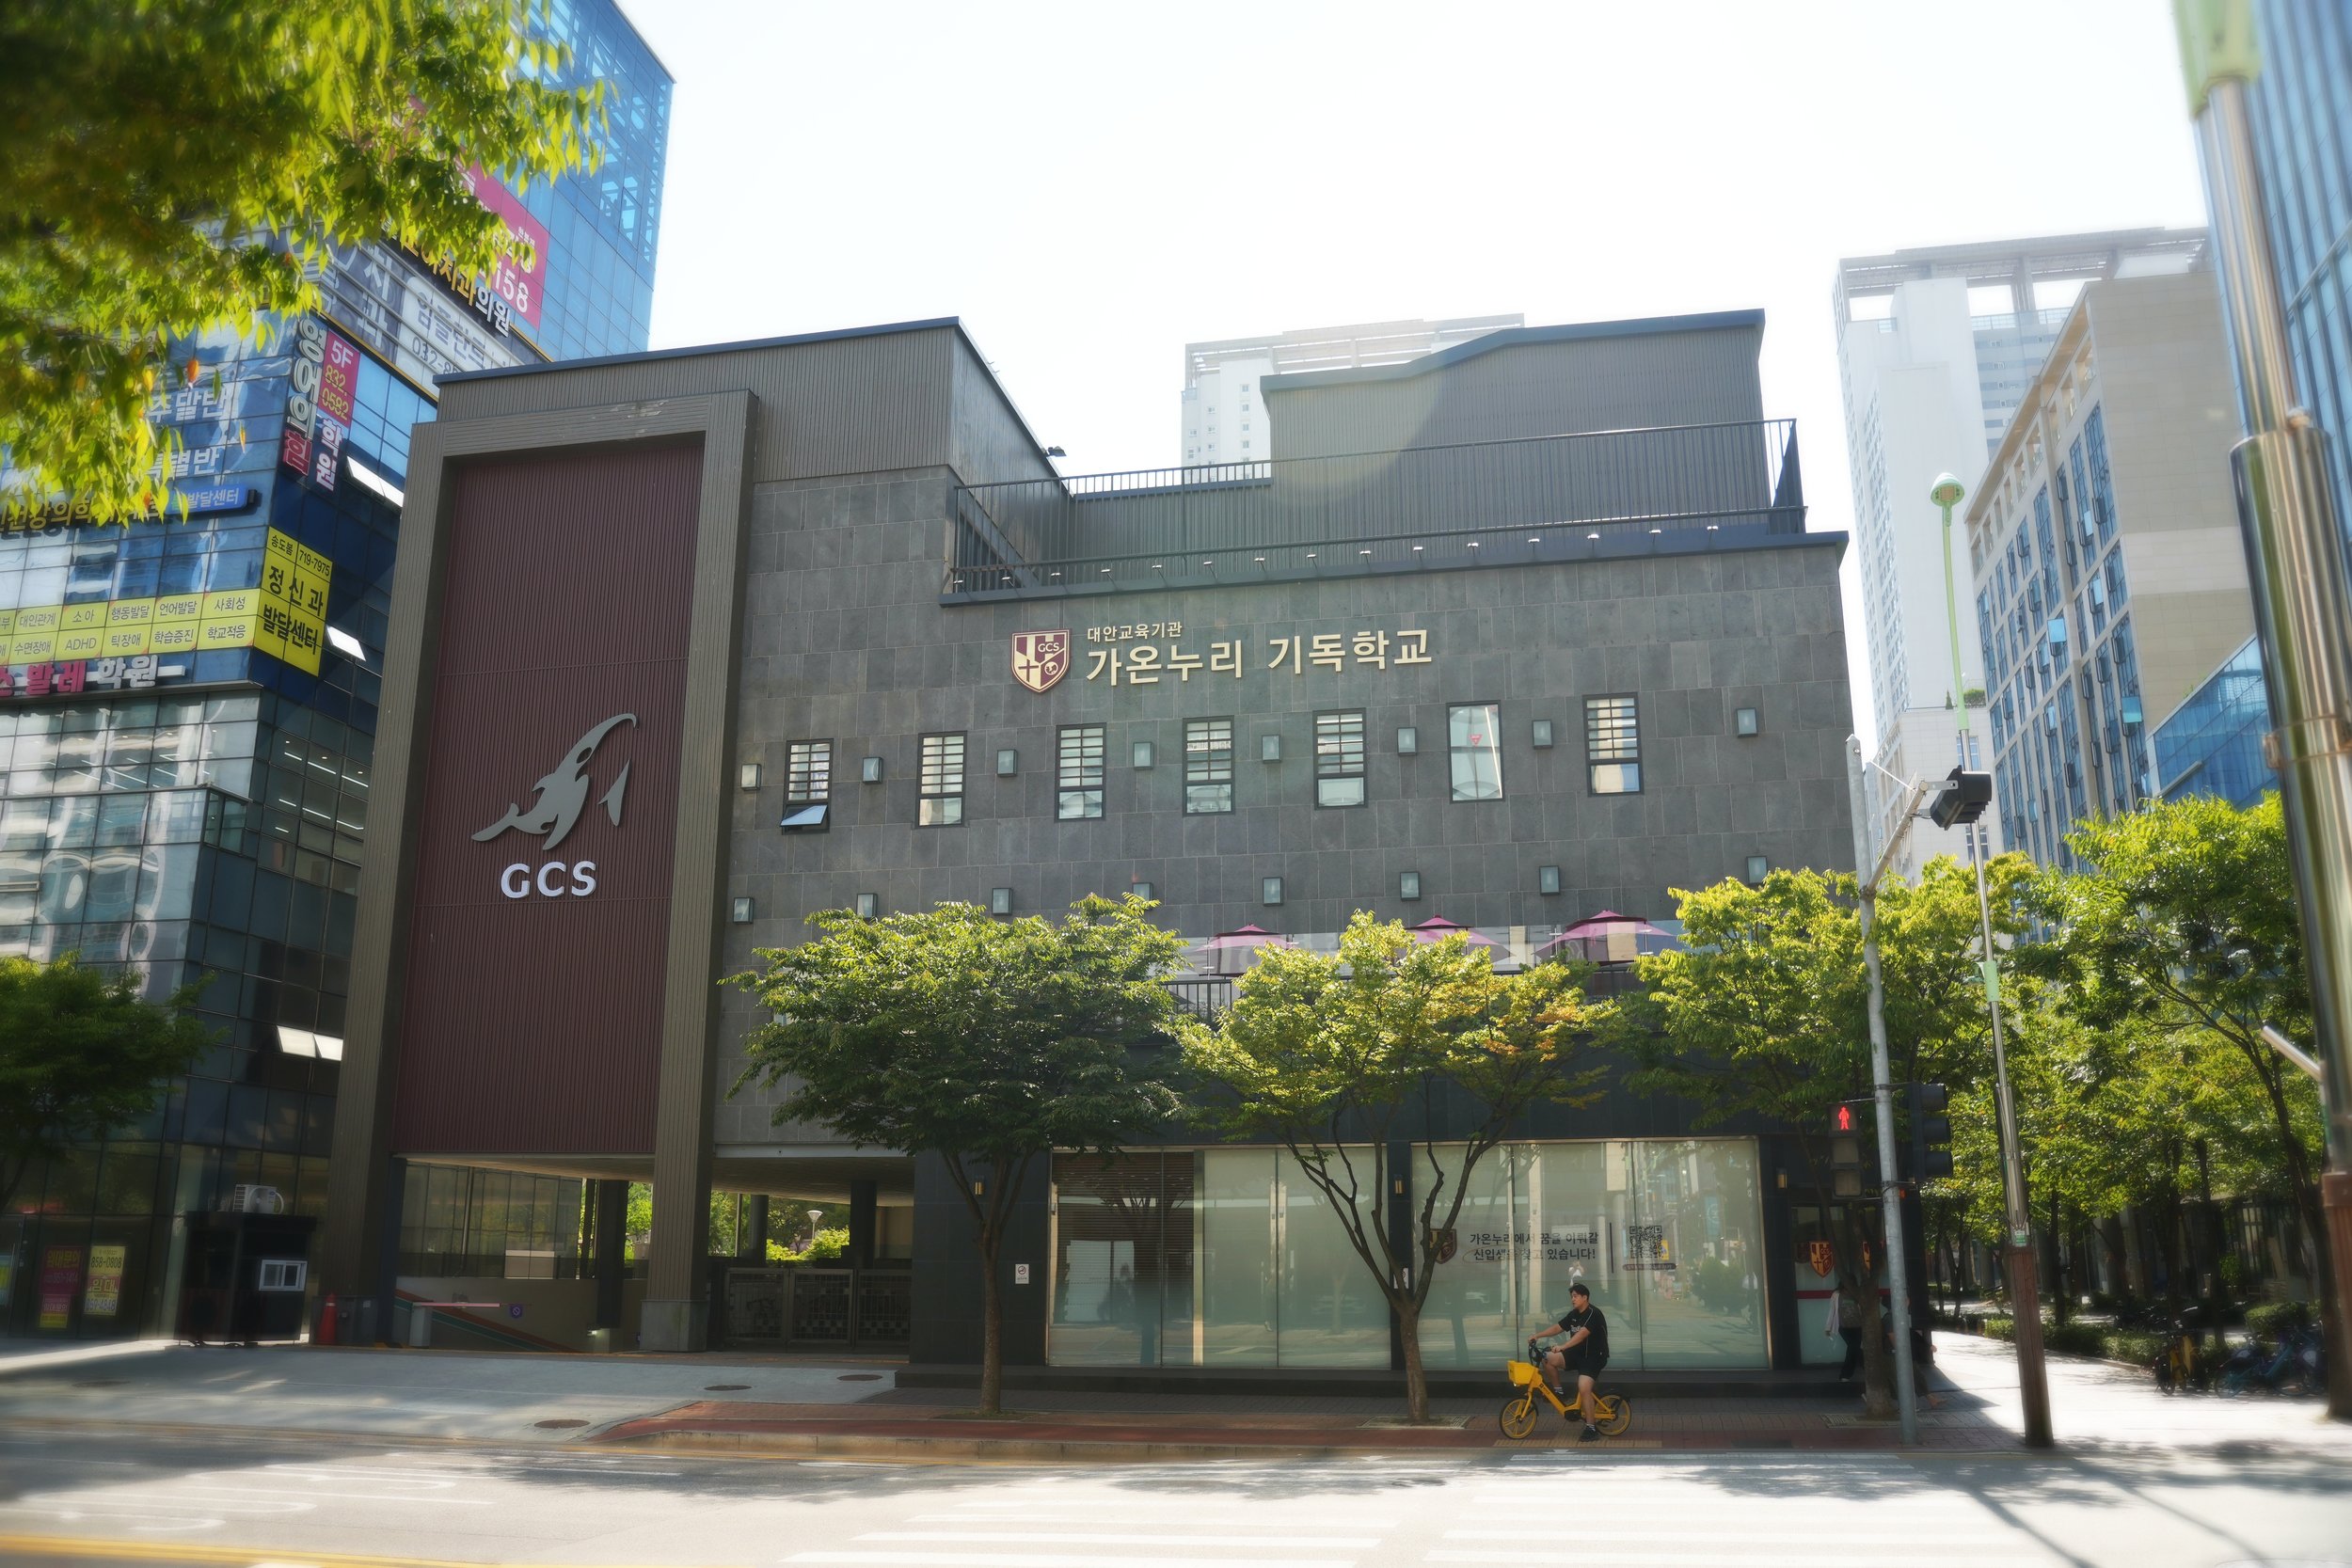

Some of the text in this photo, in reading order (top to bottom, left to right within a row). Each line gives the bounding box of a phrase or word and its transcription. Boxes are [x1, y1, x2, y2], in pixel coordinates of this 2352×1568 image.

[417, 291, 485, 371] 임플란트
[330, 340, 354, 369] 5F
[321, 388, 349, 420] 0582
[316, 418, 343, 492] 학원
[299, 549, 330, 578] 719-7975
[159, 600, 198, 616] 언어발달
[215, 596, 246, 611] 사회성
[19, 612, 56, 627] 대인관계
[111, 605, 151, 621] 행동발달
[154, 628, 195, 645] 학습증진
[207, 625, 246, 640] 학교적응
[262, 604, 319, 656] 발달센터
[1088, 621, 1183, 642] 대안교육기관
[65, 638, 97, 651] ADHD
[111, 633, 142, 647] 틱장애
[1038, 641, 1060, 653] GCS
[14, 641, 52, 656] 수면장애
[1086, 627, 1433, 687] 가온누리 기독학교
[25, 659, 87, 696] 발레
[97, 654, 159, 689] 학원
[501, 860, 597, 899] GCS
[1470, 1231, 1598, 1245] 가온누리에서 꿈을 이뤄갈
[1547, 1247, 1596, 1260] 있습니다!
[91, 1277, 116, 1292] 임대
